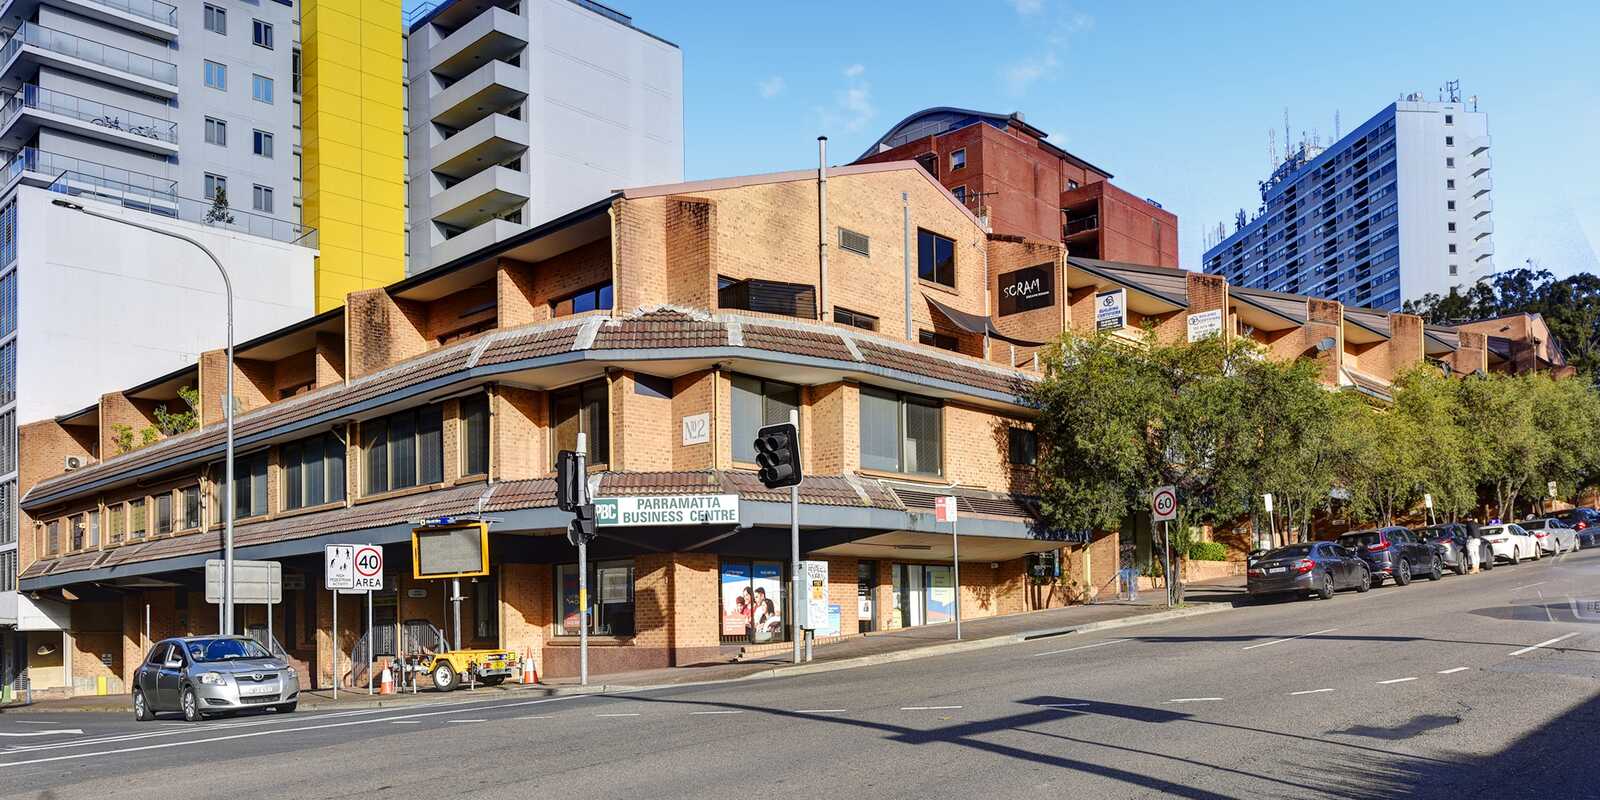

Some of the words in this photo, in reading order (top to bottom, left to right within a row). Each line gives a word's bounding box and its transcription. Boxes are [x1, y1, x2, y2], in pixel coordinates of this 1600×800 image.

[1003, 278, 1040, 298] SCRAM
[637, 497, 721, 510] PARRAMATTA
[1158, 497, 1171, 509] 60
[623, 511, 684, 523] BUSINESS
[690, 509, 736, 522] CENTRE
[359, 555, 378, 569] 40
[355, 579, 381, 587] AREA
